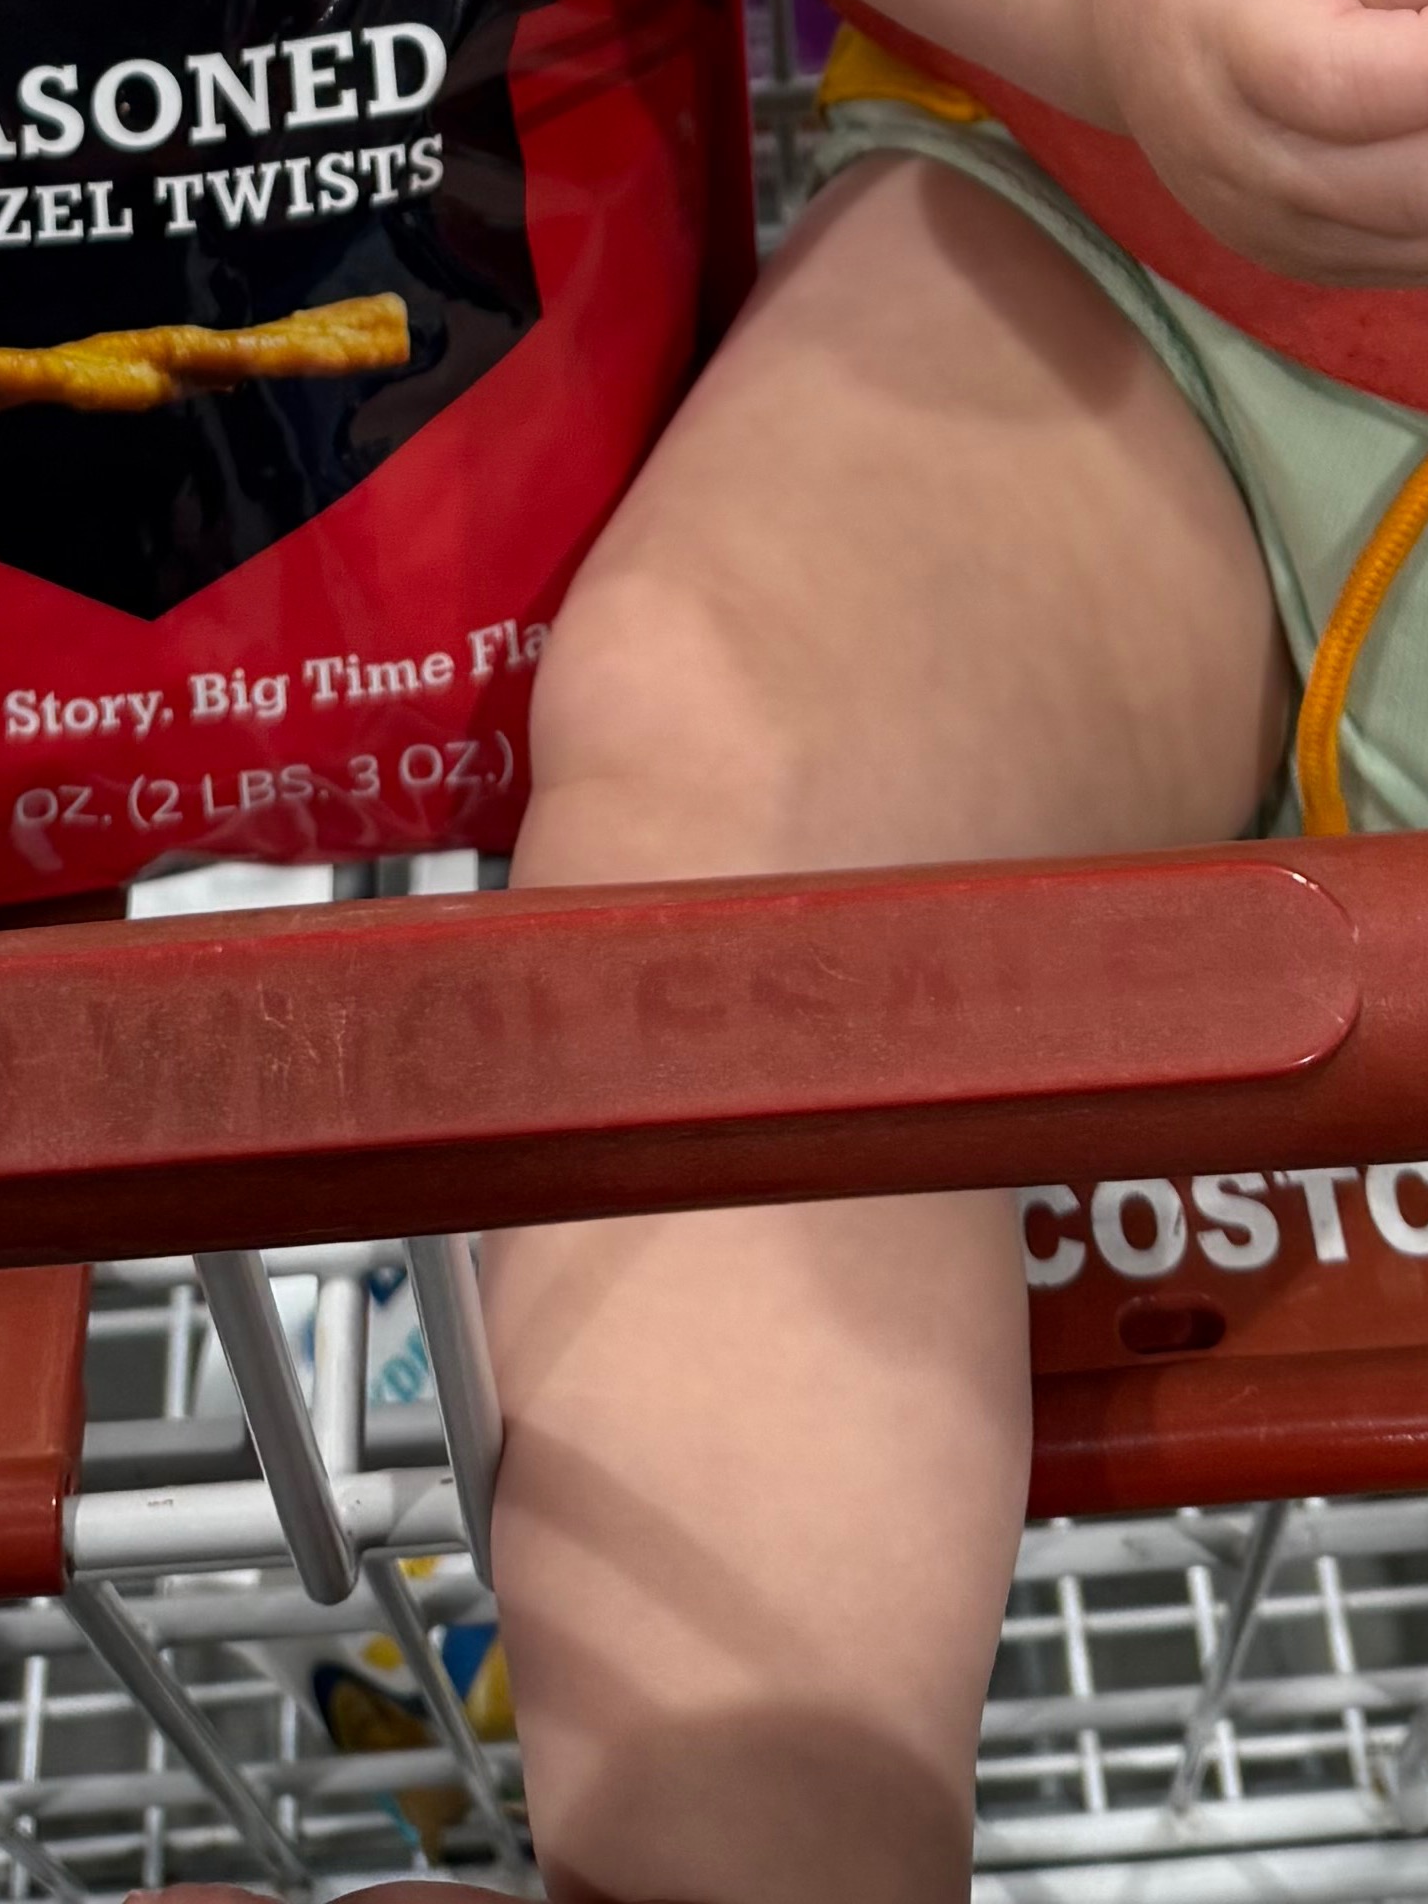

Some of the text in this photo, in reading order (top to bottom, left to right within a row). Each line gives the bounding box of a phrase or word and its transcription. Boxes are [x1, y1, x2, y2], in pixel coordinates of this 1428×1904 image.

[156, 133, 444, 239] TWISTS
[188, 667, 290, 722] Big
[302, 652, 456, 706] Time
[466, 618, 552, 679] Fla
[13, 784, 113, 831] OZ.
[127, 774, 184, 832] (2
[347, 753, 382, 800] 3
[397, 729, 515, 792] OZ.)
